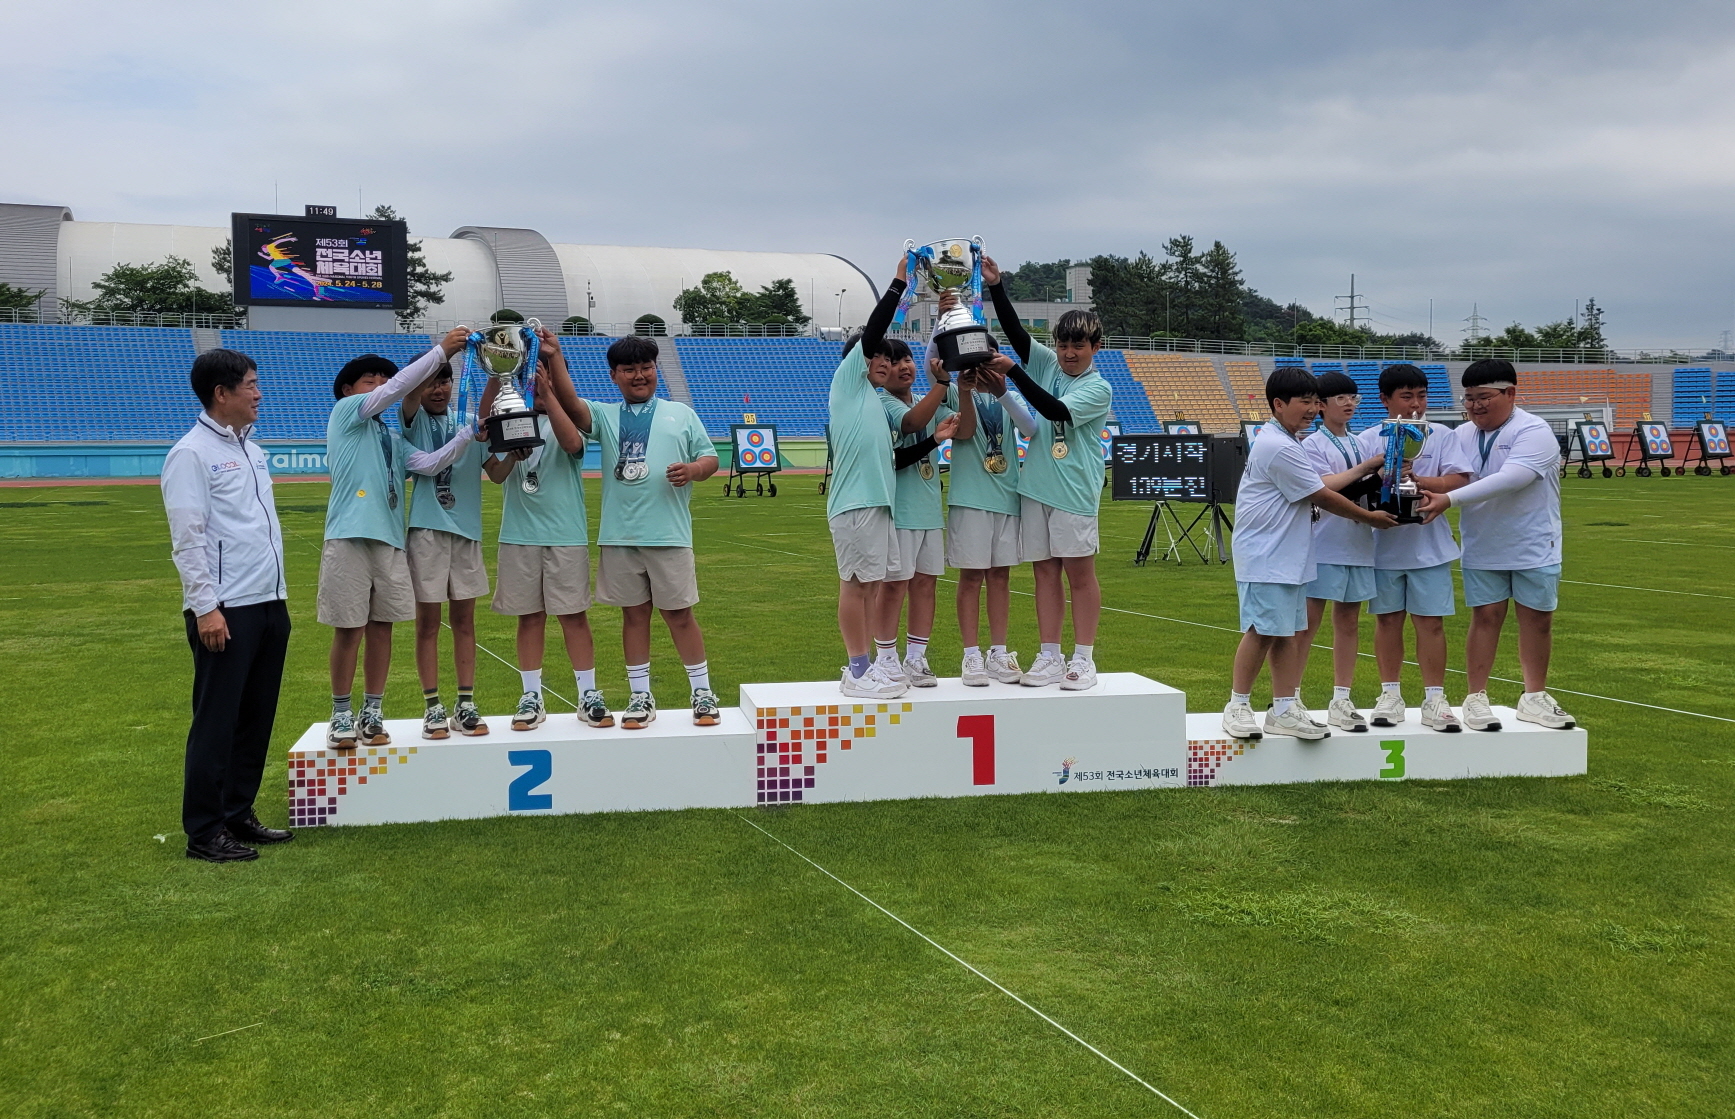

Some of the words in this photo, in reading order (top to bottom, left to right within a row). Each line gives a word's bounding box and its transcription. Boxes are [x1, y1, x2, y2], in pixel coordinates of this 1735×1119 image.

[309, 207, 334, 216] 11:49
[315, 238, 349, 248] 제53회
[315, 248, 382, 263] 전국소년
[316, 261, 383, 277] 체육대회
[745, 414, 755, 423] 25
[1117, 442, 1207, 463] 경기시작
[956, 714, 996, 786] 1
[1379, 740, 1405, 779] 3
[508, 749, 553, 812] 2
[1073, 770, 1104, 782] 제53회
[1106, 767, 1179, 781] 전국소년체육대회
